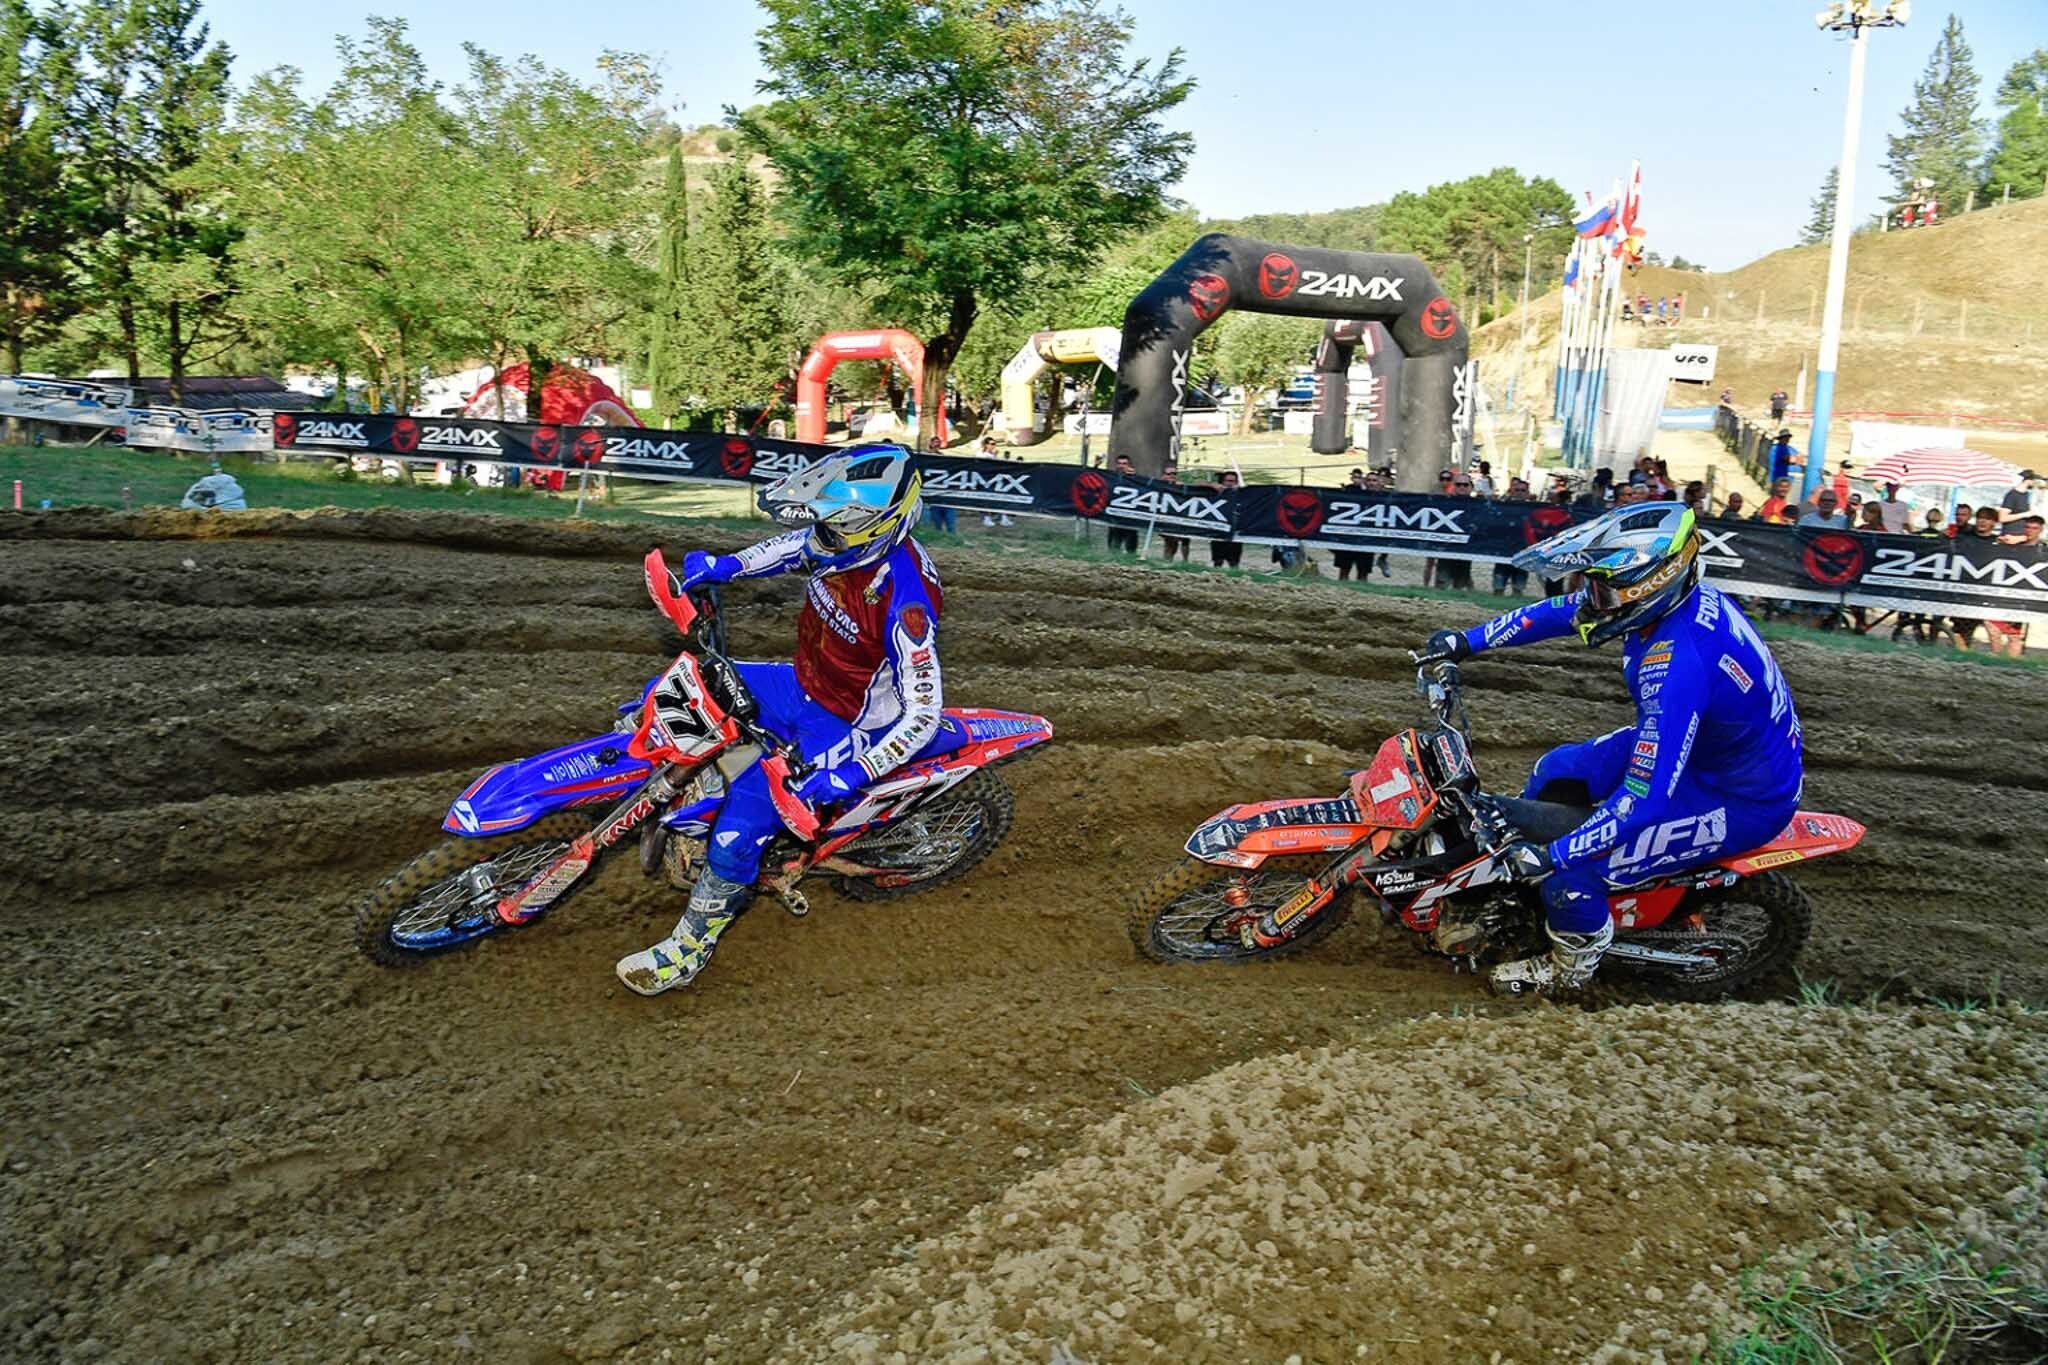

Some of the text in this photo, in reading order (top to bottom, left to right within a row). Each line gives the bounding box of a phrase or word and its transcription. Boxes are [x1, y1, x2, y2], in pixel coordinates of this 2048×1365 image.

[1298, 271, 1404, 300] 24MX
[1675, 354, 1708, 365] UFO
[1169, 350, 1189, 461] 24MX
[299, 420, 366, 440] 24MX
[422, 426, 500, 447] 24MX
[604, 438, 691, 461] 24MX
[923, 469, 1033, 495] 24MX
[1111, 486, 1228, 522] 24MX
[1327, 501, 1465, 533] 24MX
[1627, 553, 1684, 598] OAKLEY
[1870, 548, 2048, 590] 24MX
[835, 608, 859, 634] ORO
[1370, 768, 1411, 804] 1
[1568, 819, 1617, 853] UFO
[1608, 807, 1727, 869] UFO
